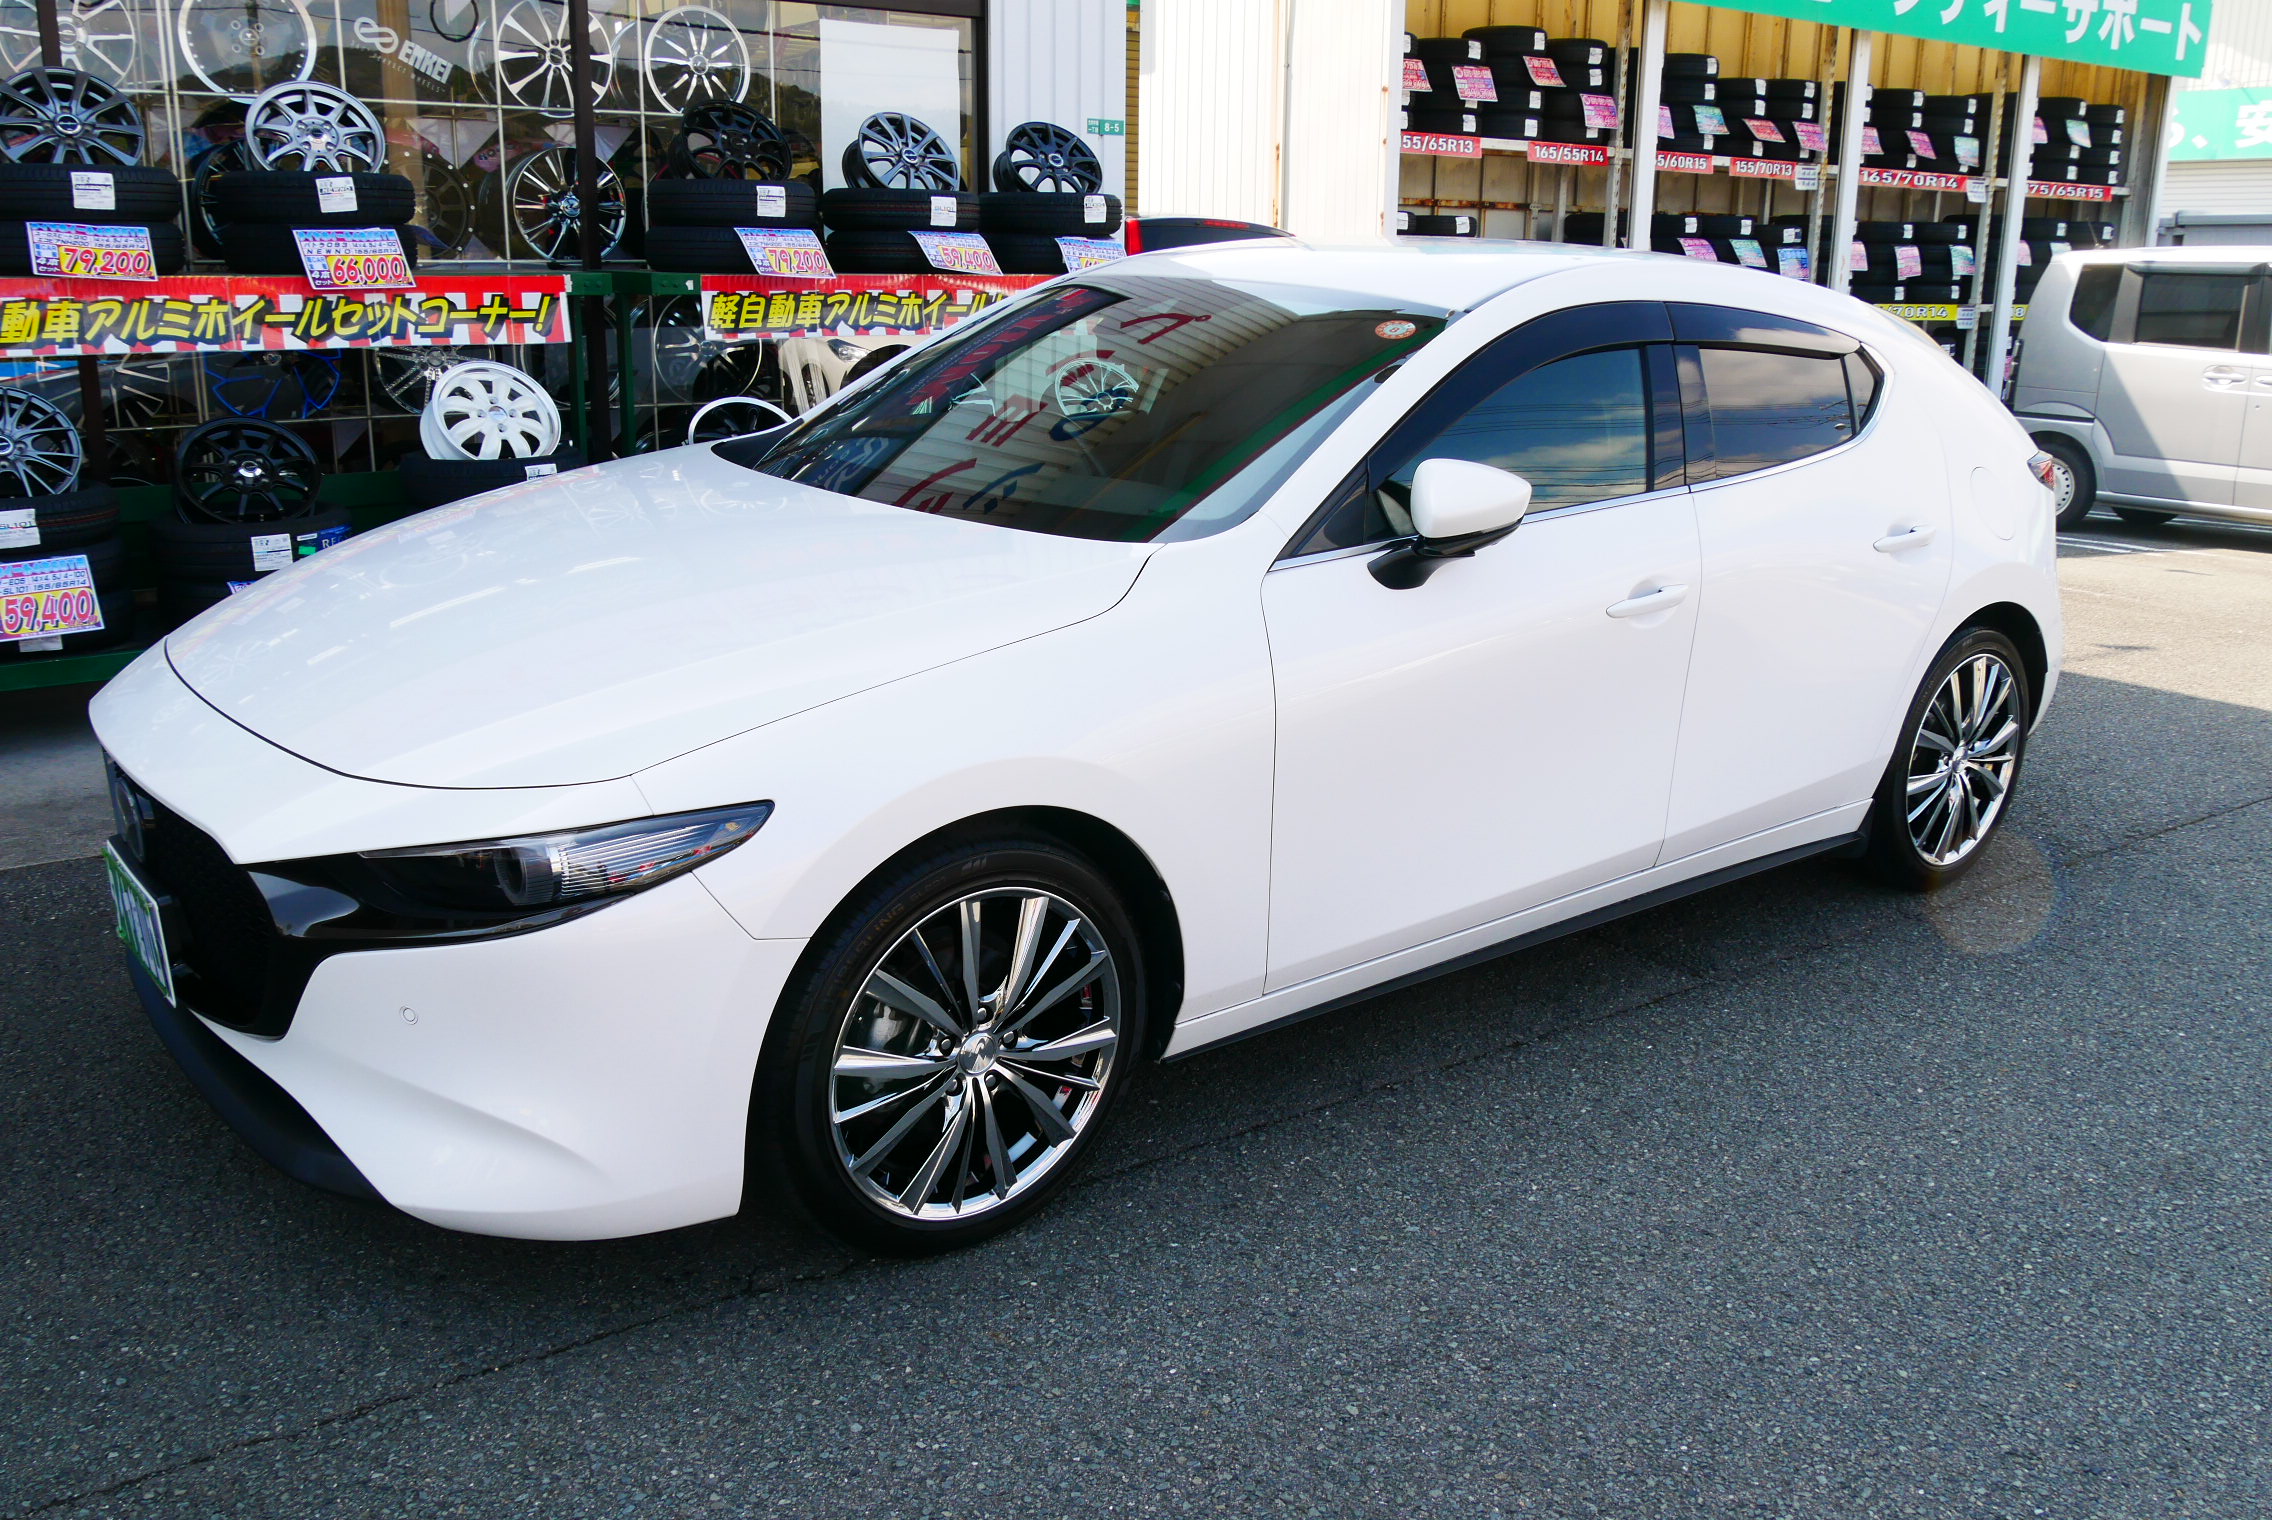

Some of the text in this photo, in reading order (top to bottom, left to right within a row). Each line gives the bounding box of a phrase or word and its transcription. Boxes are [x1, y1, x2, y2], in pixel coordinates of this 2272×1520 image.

[398, 39, 453, 84] ENKEI
[1104, 122, 1120, 132] 8-5
[1534, 145, 1604, 163] 165/55R14
[1735, 160, 1793, 176] 155/70R13
[1861, 170, 1959, 189] 165/70R14
[63, 247, 149, 275] 79,200
[333, 256, 405, 284] 66,000
[767, 249, 827, 273] 79,200
[941, 247, 994, 271] 59,400
[4, 588, 93, 632] 59,400
